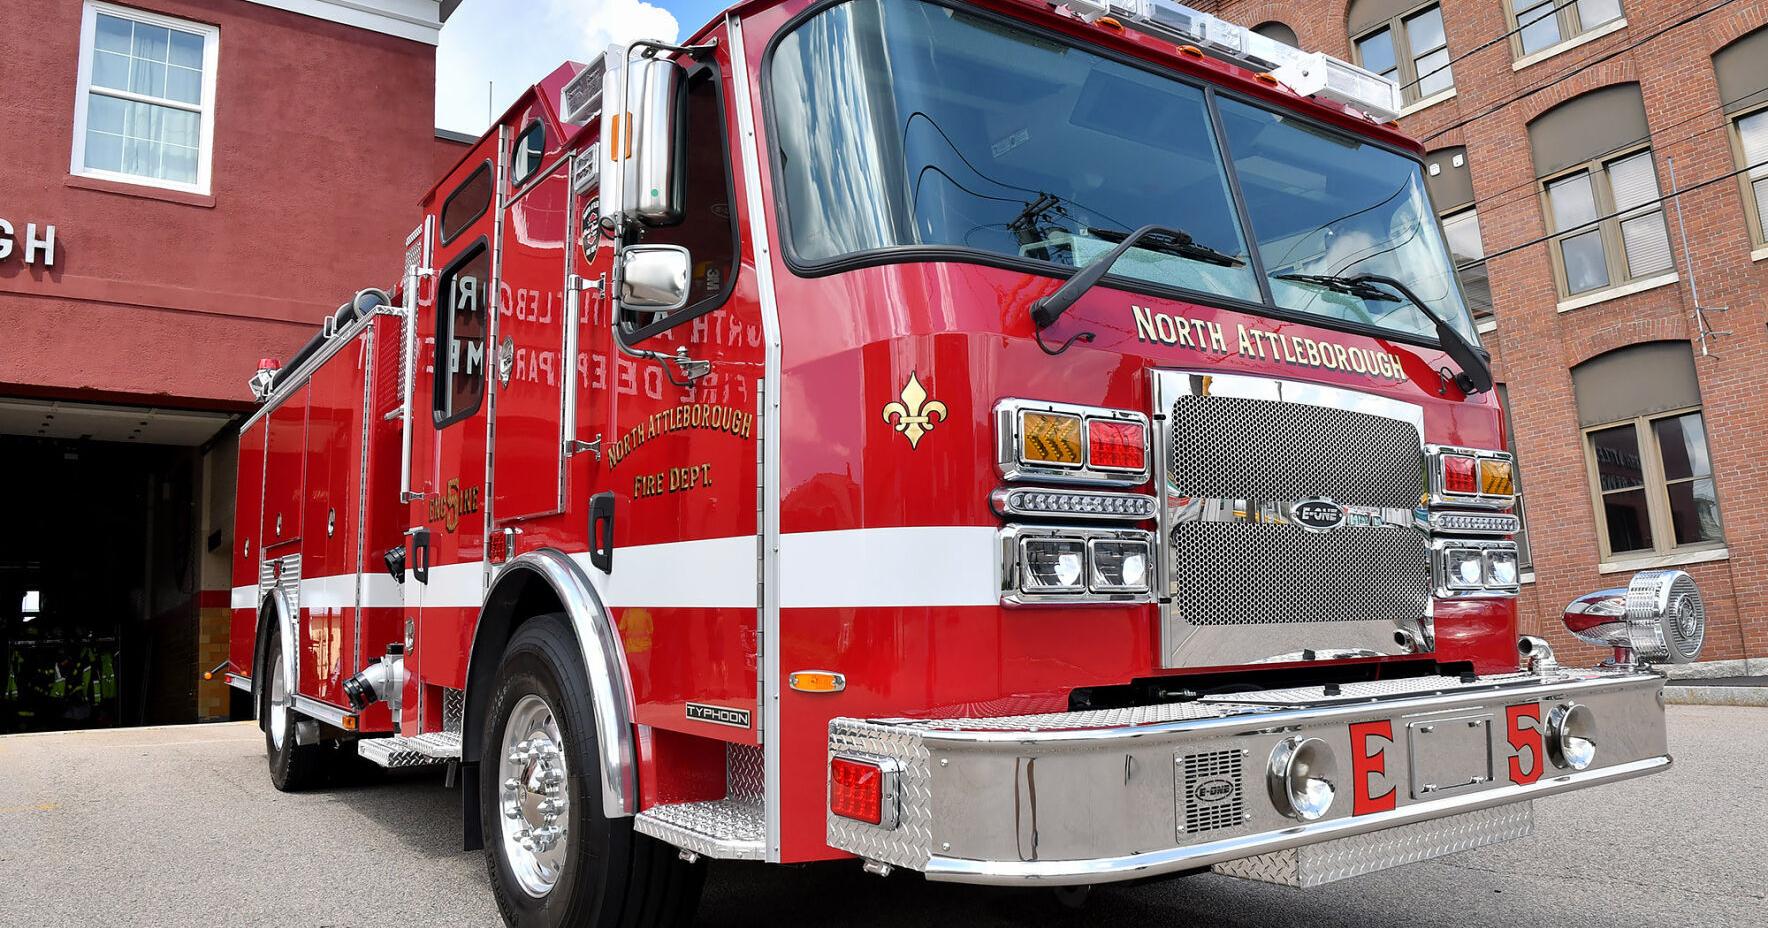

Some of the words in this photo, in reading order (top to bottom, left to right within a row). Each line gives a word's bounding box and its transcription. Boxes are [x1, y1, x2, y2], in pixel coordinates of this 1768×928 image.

[1131, 305, 1227, 354] NORTH
[1236, 324, 1407, 380] ATTLEBOROUGH
[607, 422, 645, 471] NORTH
[647, 403, 753, 440] ATTLEBOROUGH
[633, 472, 665, 499] FIRE
[668, 463, 713, 493] DEPT.
[1302, 507, 1338, 520] E-ONE
[687, 706, 748, 724] TYPHOON
[1349, 719, 1397, 817] E
[1505, 702, 1544, 785] 5
